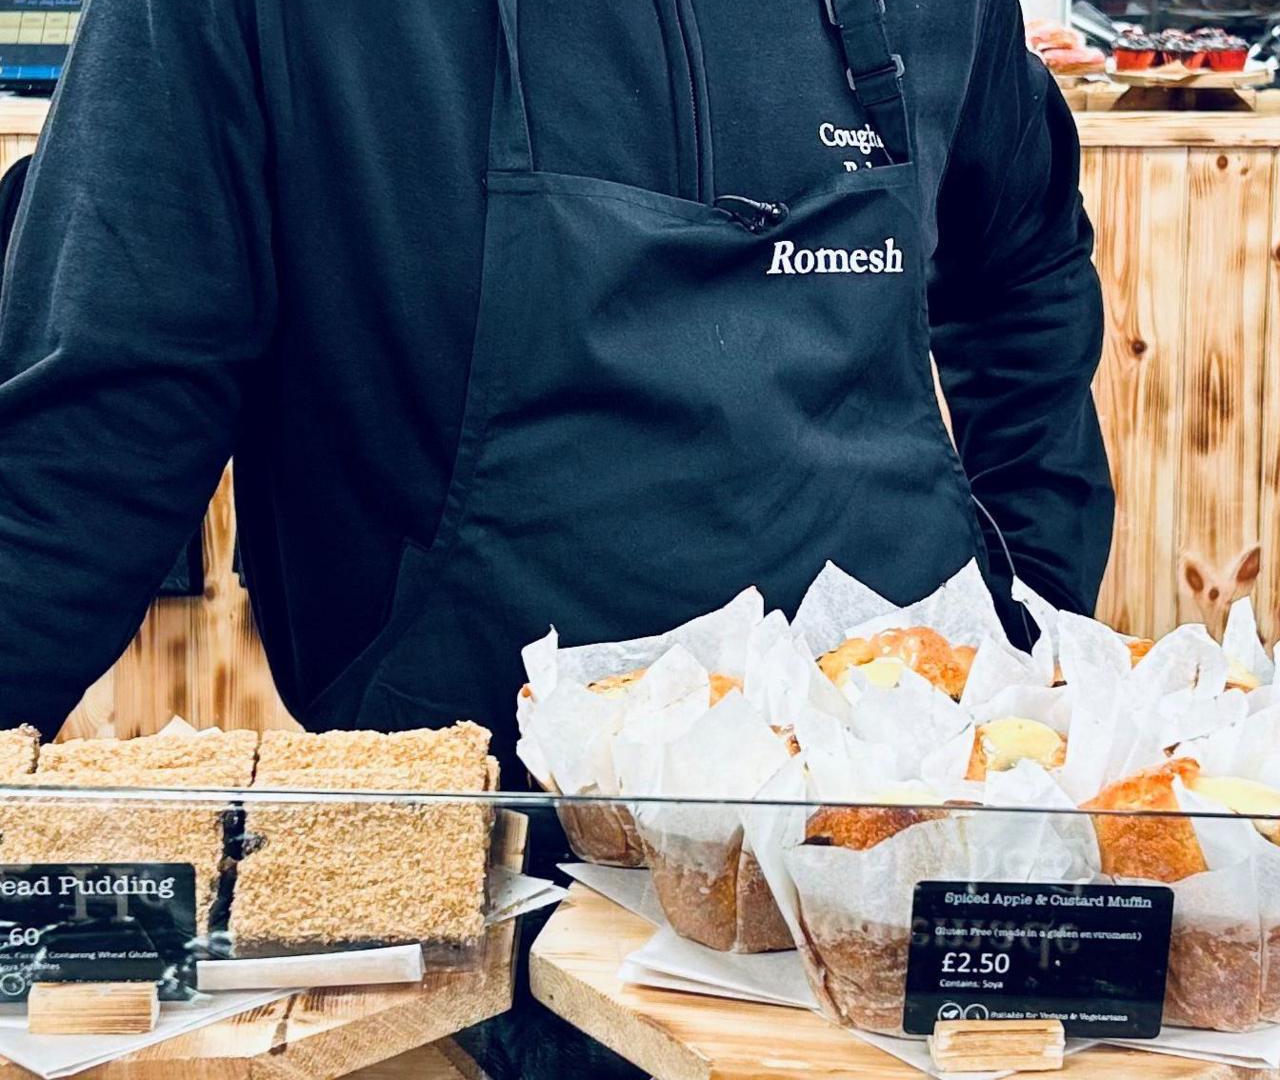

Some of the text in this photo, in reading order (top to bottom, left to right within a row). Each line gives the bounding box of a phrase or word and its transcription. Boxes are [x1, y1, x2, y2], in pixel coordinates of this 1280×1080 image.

[819, 123, 884, 155] Cough
[766, 237, 904, 275] Romesh
[58, 875, 175, 899] Pudding
[944, 891, 1152, 909] Spiced Apple & Custard Muffin
[48, 951, 96, 961] Containing
[98, 951, 126, 959] Wheat
[128, 950, 158, 959] Gluten
[941, 953, 1010, 973] £2.50
[939, 979, 1004, 990] Contains: Soya
